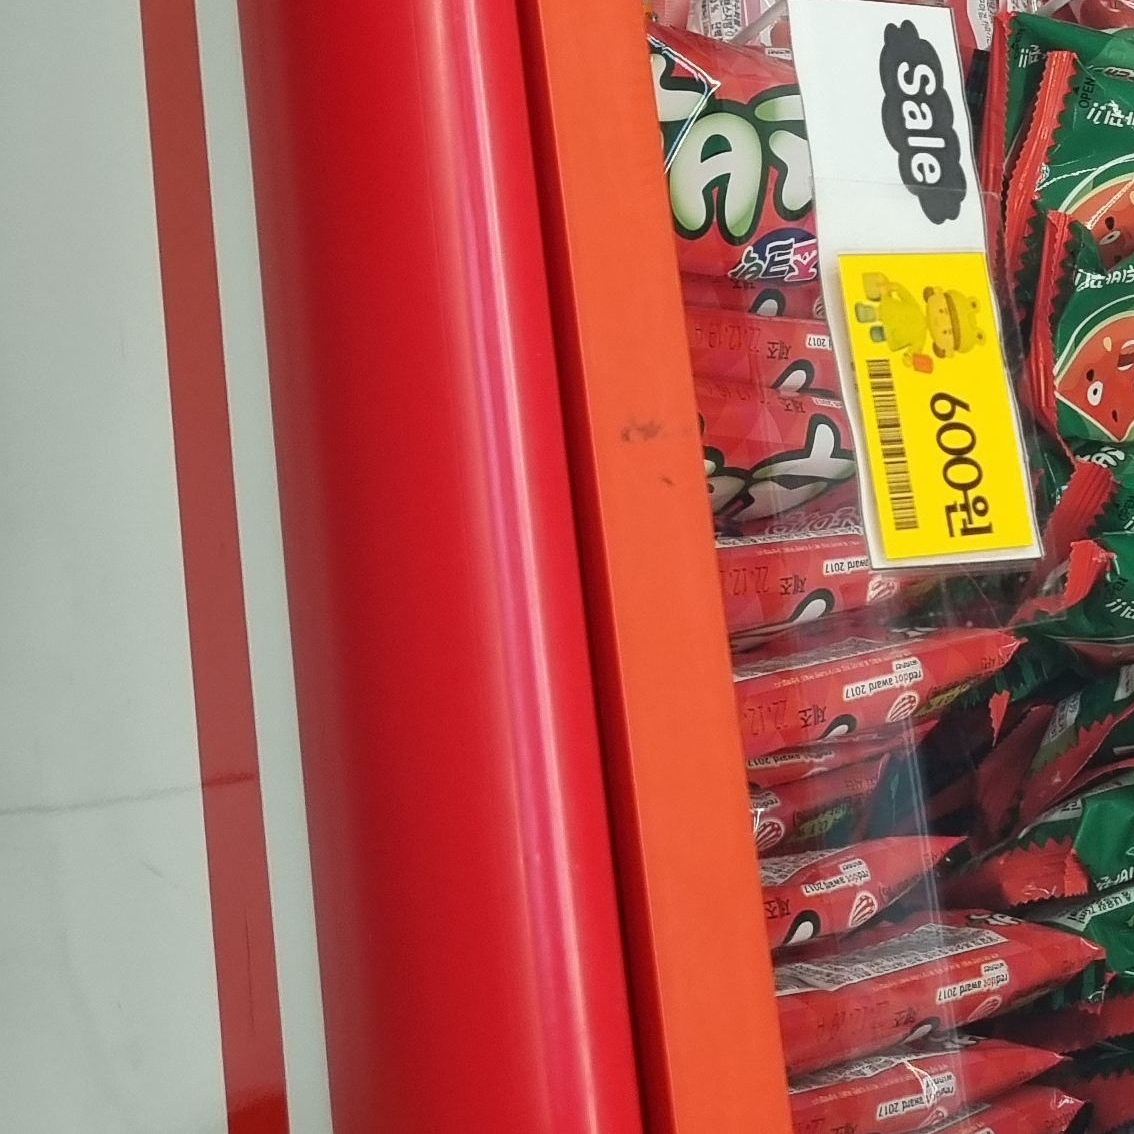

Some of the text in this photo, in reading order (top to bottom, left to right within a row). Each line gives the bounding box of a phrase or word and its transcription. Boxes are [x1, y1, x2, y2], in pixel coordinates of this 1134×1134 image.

[1075, 74, 1094, 109] OPEN
[892, 56, 952, 187] Sale
[766, 339, 792, 362] 제조
[923, 387, 994, 539] 600원
[823, 561, 844, 573] 2017
[779, 573, 807, 595] 제조
[843, 683, 867, 699] 2017
[866, 676, 894, 693] award
[797, 703, 829, 728] 제조
[763, 896, 792, 920] 제조
[935, 986, 959, 1002] 2017
[957, 979, 984, 996] award
[874, 1101, 901, 1117] 2017
